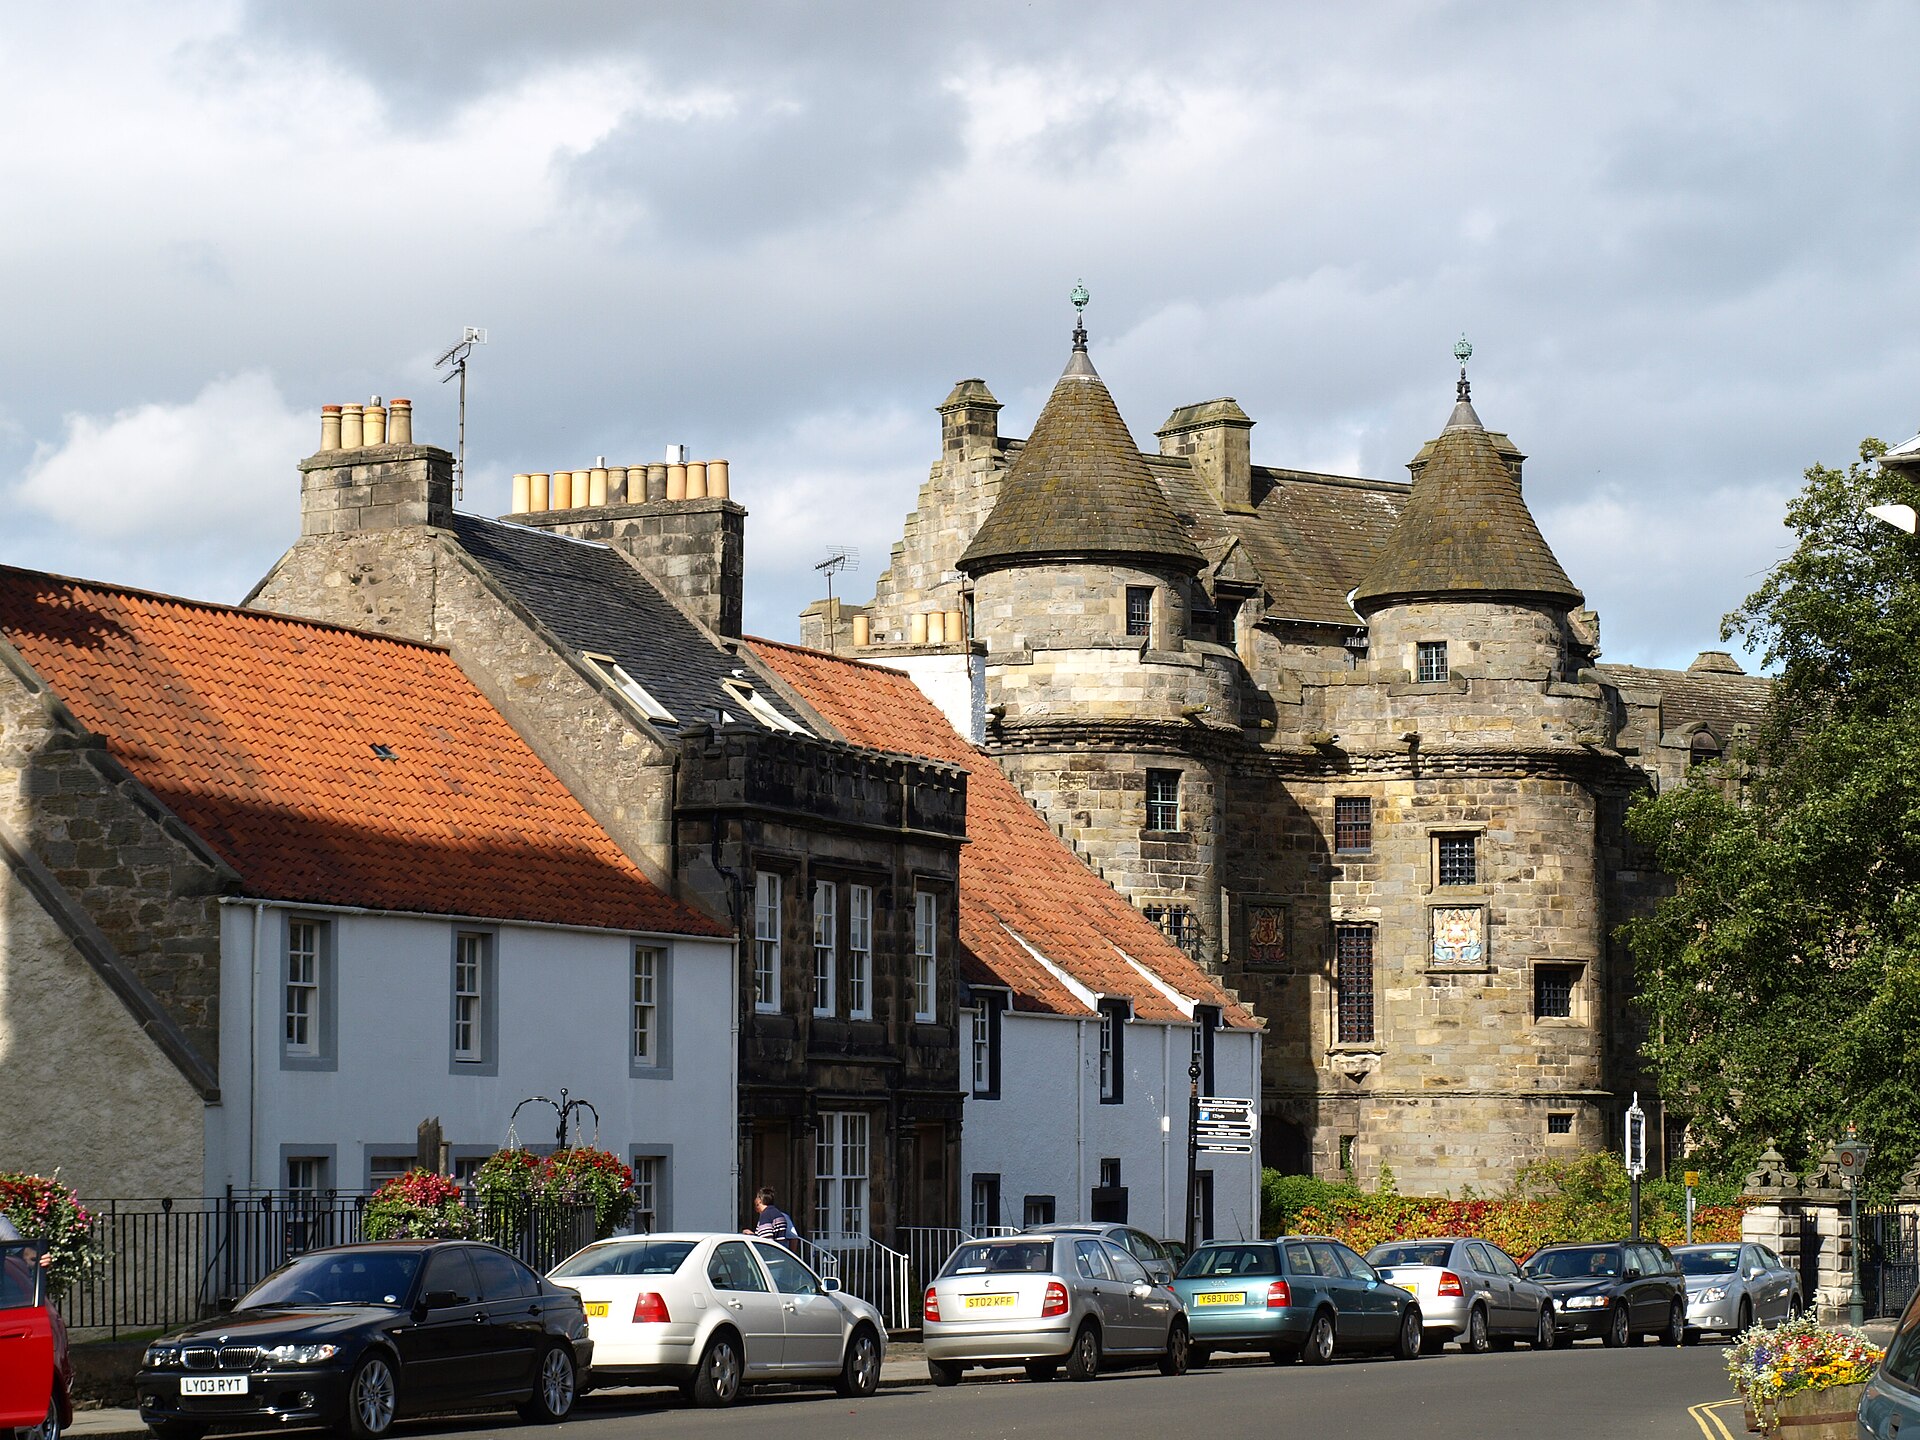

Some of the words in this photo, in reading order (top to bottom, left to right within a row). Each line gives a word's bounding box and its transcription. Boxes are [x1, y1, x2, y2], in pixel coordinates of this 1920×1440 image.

[968, 1297, 993, 1308] ST02
[994, 1296, 1012, 1306] KFF
[589, 1305, 605, 1316] UD
[185, 1379, 215, 1393] LY03
[218, 1378, 242, 1392] RYT
